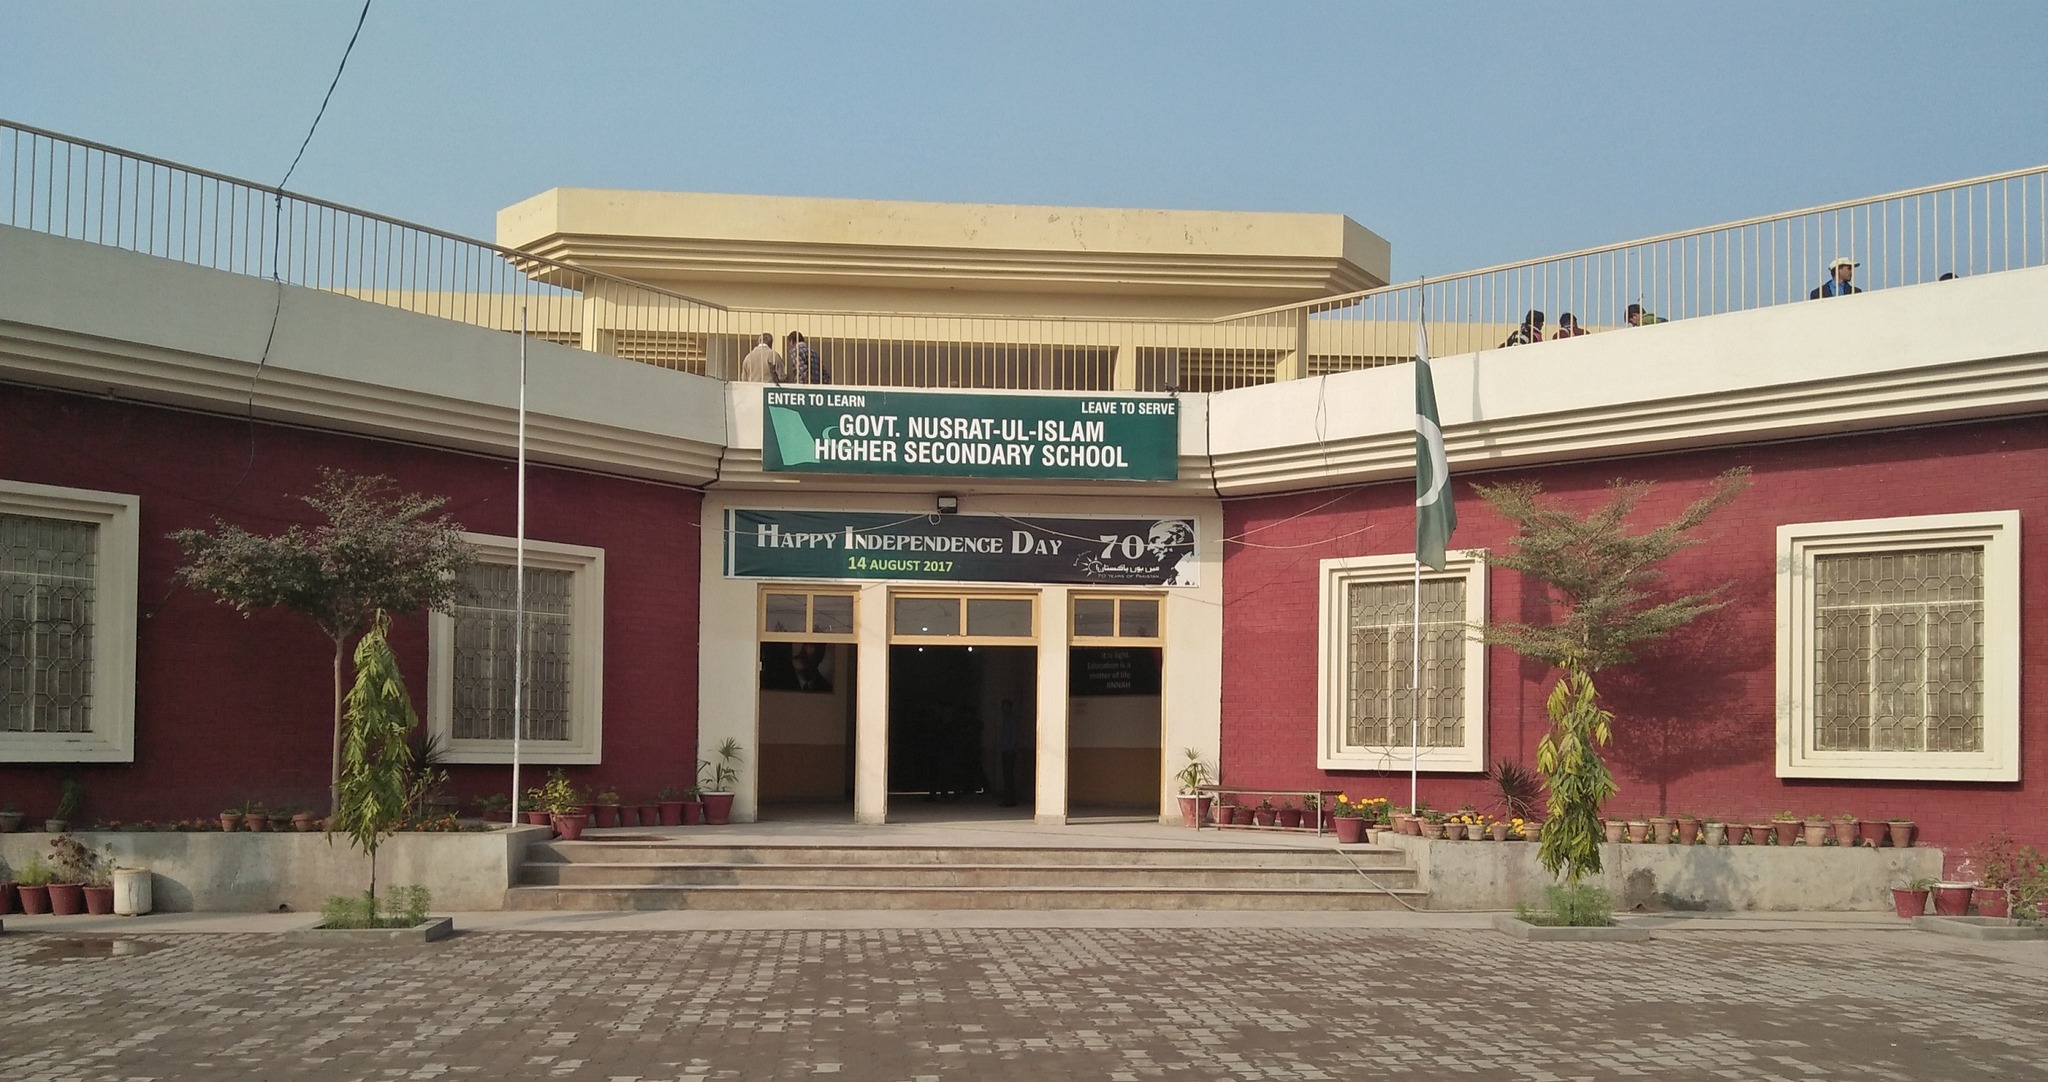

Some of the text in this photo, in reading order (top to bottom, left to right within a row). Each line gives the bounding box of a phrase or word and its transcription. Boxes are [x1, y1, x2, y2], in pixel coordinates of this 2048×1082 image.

[767, 392, 866, 408] ENTER TO LEARN
[1081, 402, 1176, 416] LEAVE TO SERVE
[839, 414, 1105, 443] GOVT. NUSRAT-UL-ISLAM
[814, 438, 1129, 468] HIGHER SECONDARY SCHOOL
[1099, 534, 1145, 560] 70
[848, 556, 953, 573] 14 AUGUST 2017
[1087, 662, 1119, 670] Education
[1112, 671, 1119, 679] of
[1120, 671, 1131, 679] life
